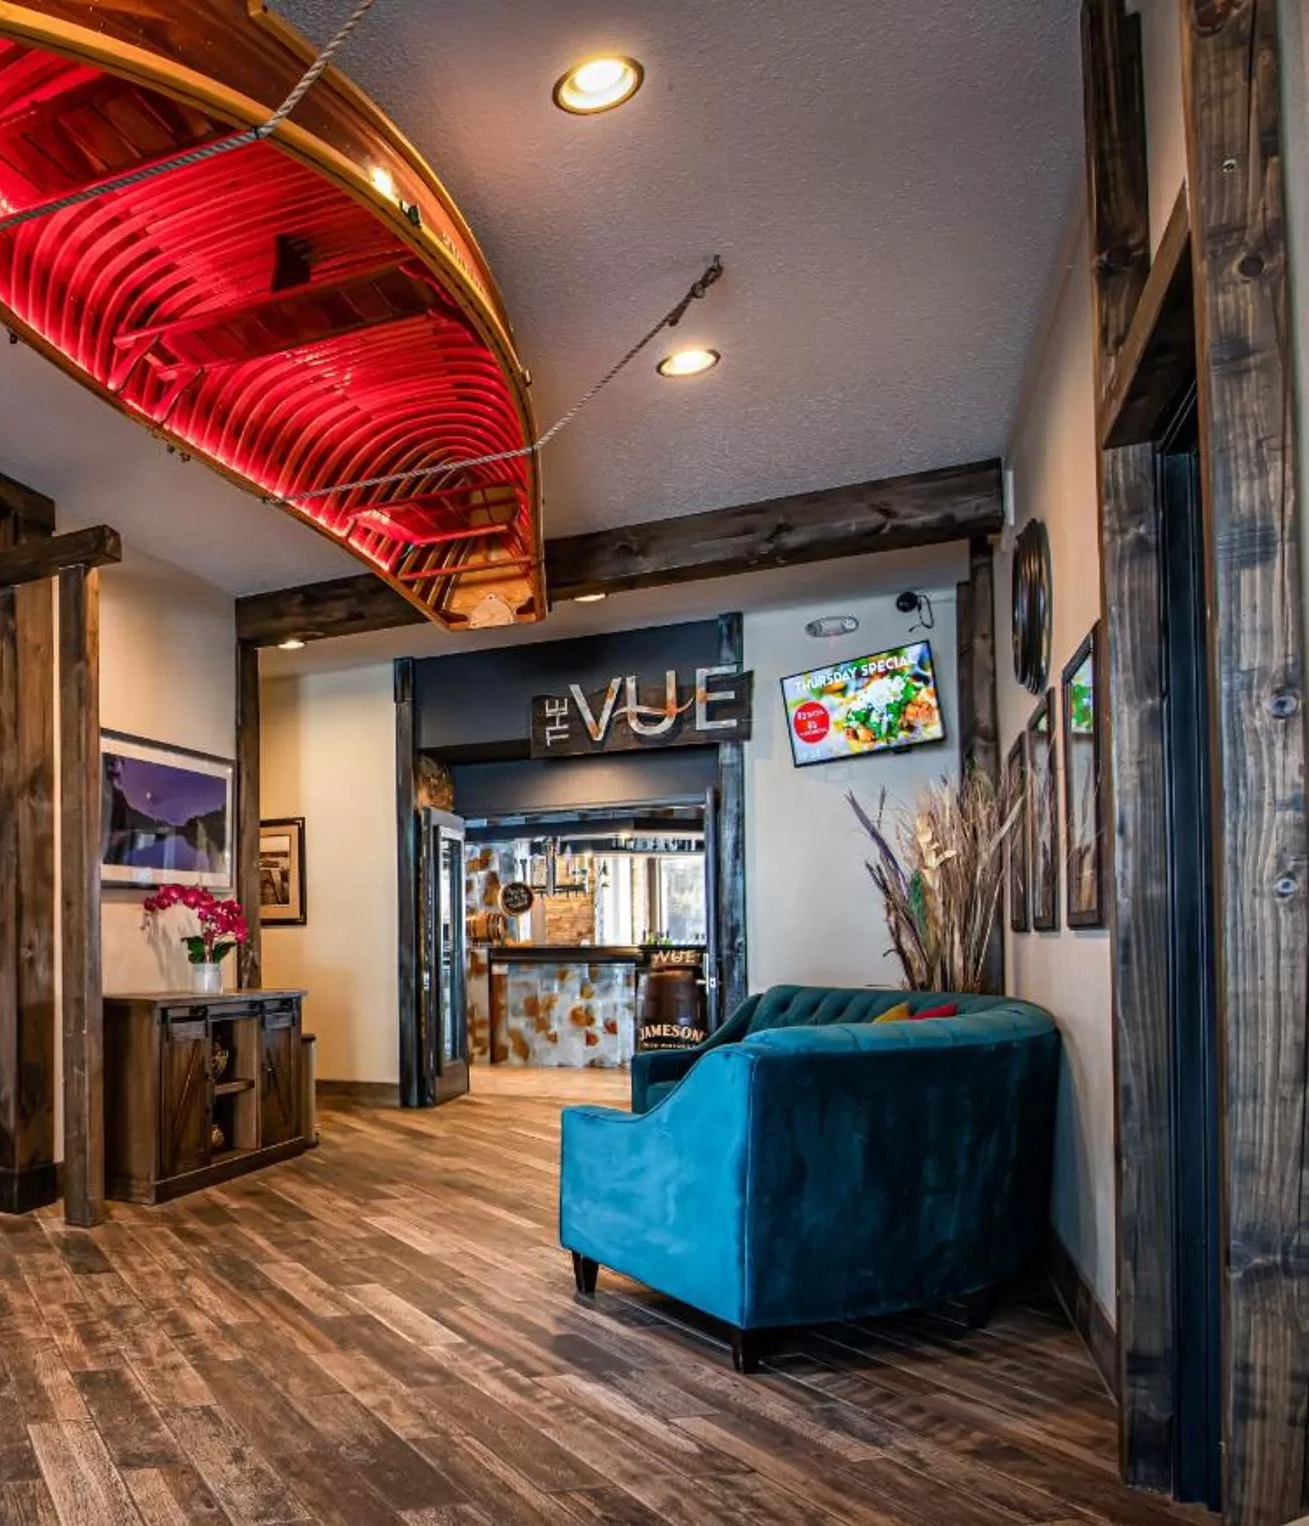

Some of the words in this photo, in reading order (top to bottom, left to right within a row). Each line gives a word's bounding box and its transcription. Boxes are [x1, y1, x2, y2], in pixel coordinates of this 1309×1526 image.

[794, 667, 857, 693] THURSDAY
[861, 654, 917, 676] SPECIAL
[545, 697, 570, 746] THE
[568, 665, 738, 741] VUE
[640, 1024, 704, 1043] JAMESON
